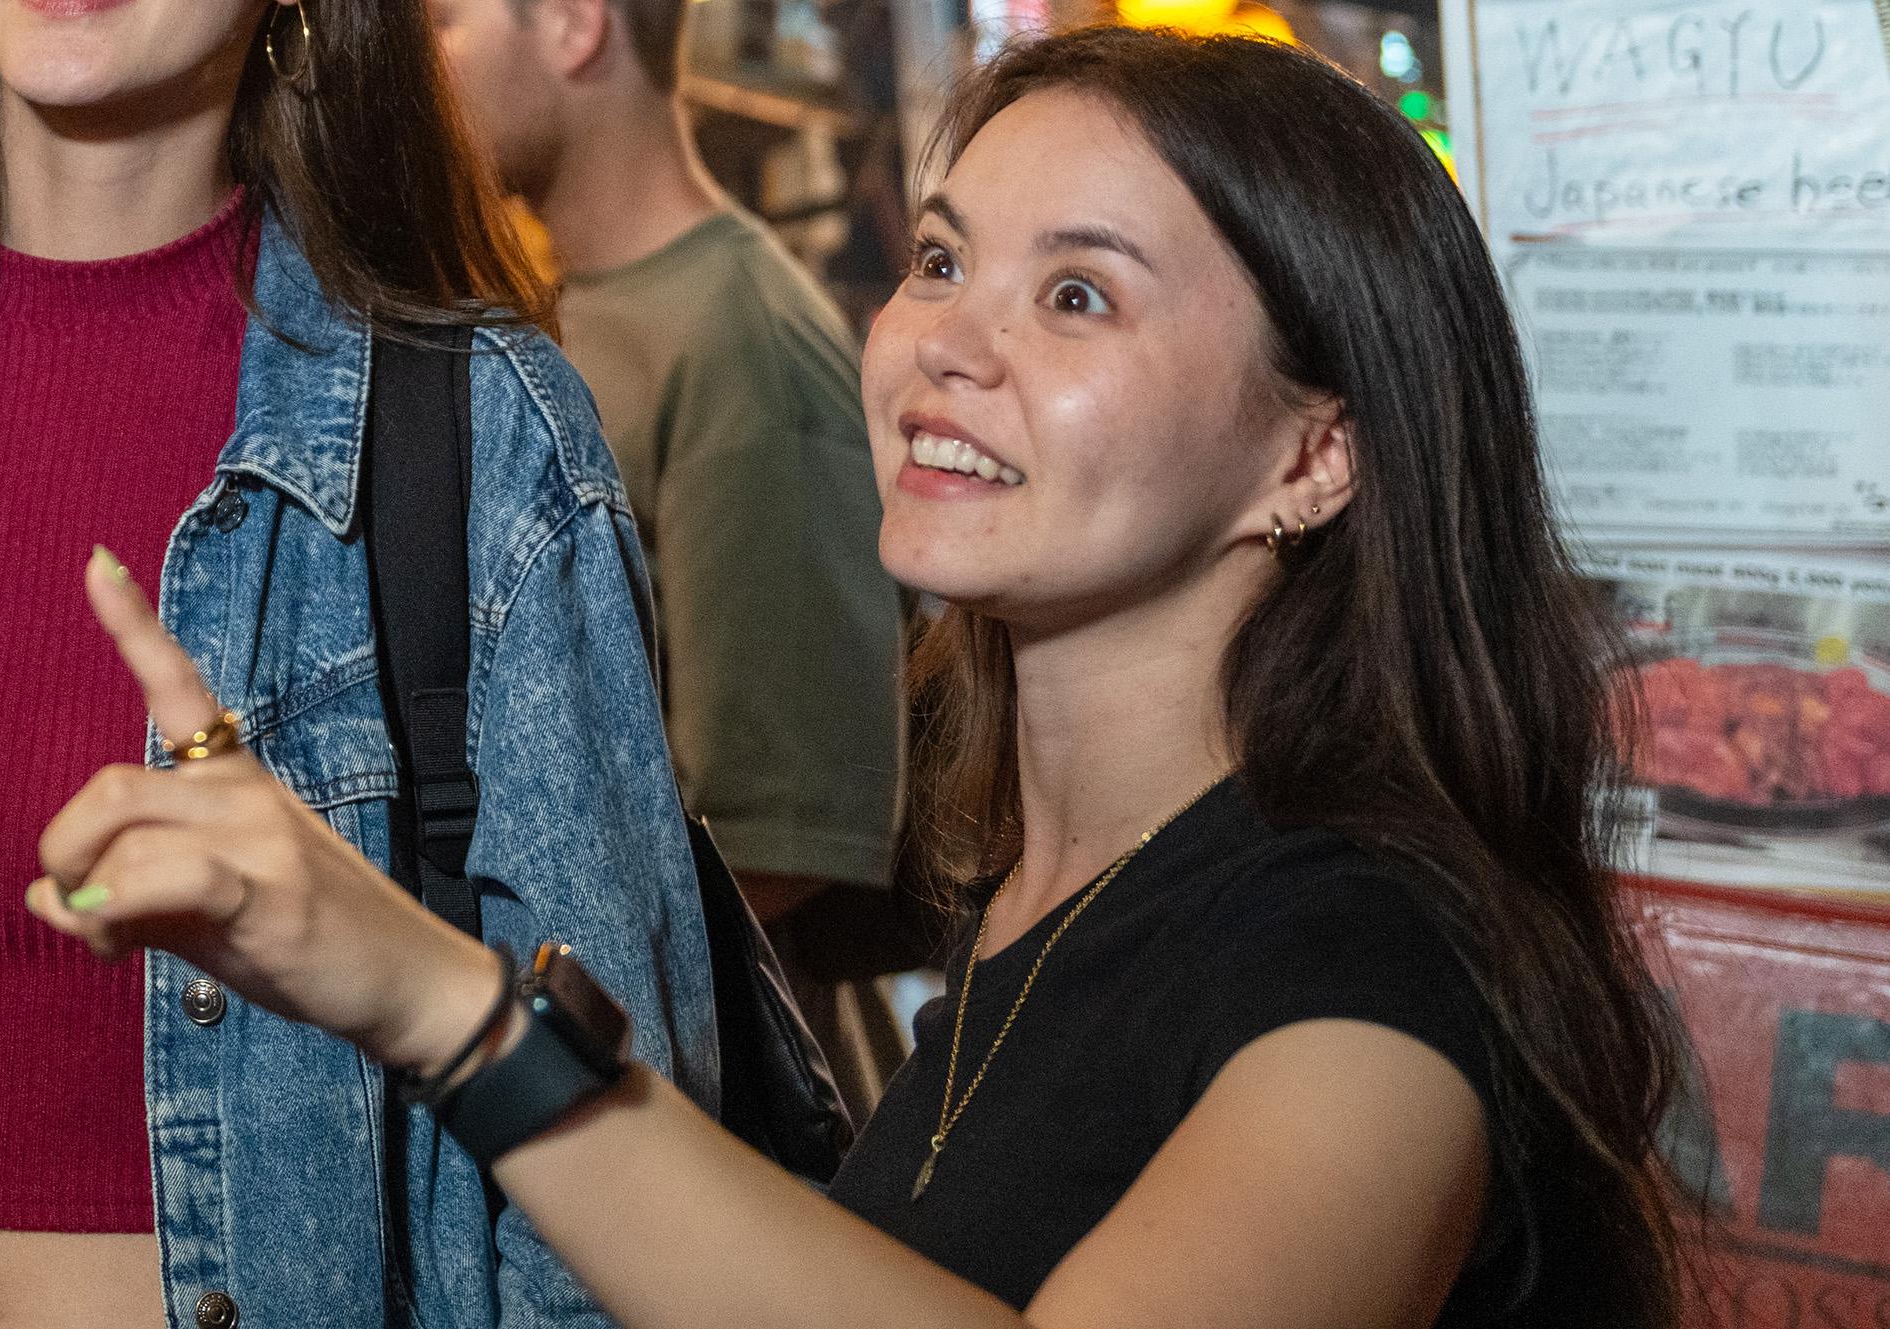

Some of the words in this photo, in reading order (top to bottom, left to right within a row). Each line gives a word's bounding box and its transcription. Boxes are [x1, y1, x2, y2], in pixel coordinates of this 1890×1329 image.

[1516, 9, 1828, 101] WAGYU
[1523, 148, 1766, 220] Japanese
[1791, 146, 1890, 216] bee
